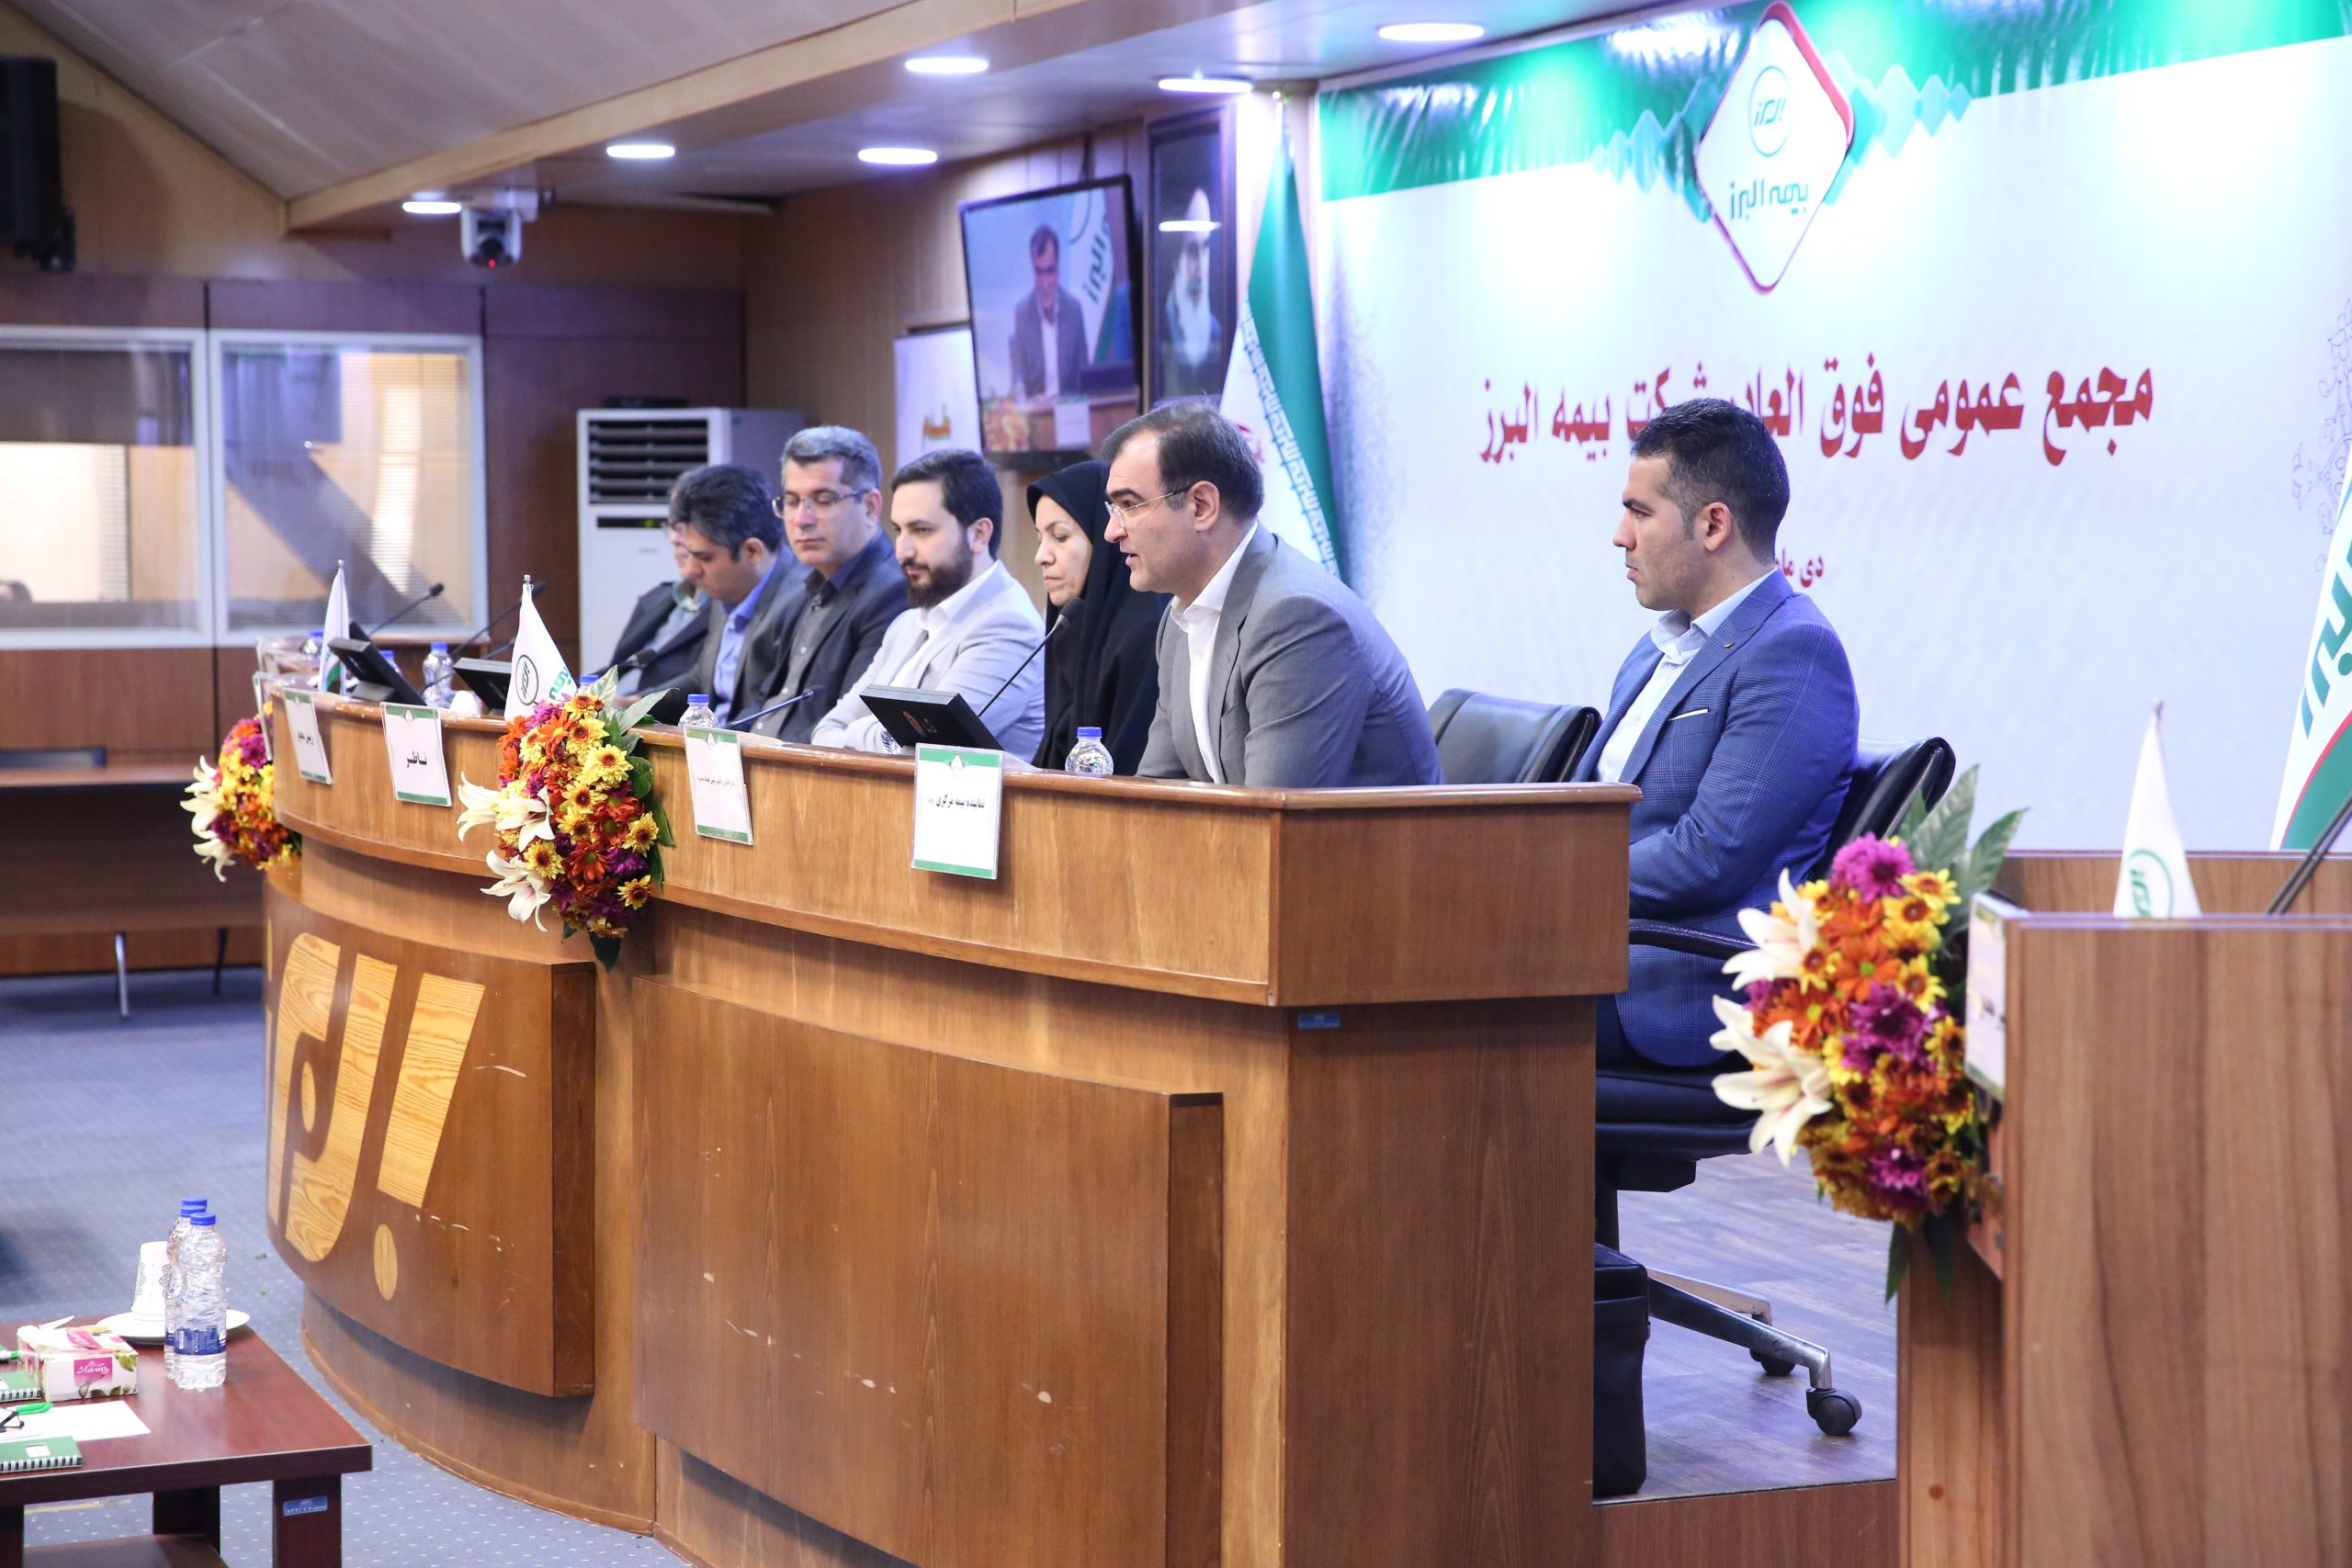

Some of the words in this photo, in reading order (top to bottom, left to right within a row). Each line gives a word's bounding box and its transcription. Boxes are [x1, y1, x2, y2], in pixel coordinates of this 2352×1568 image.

[1479, 378, 1539, 464] البرز
[1552, 387, 1611, 459] بیمه
[1730, 364, 1804, 437] العا
[1820, 351, 1884, 458] فوق
[1900, 371, 2025, 460] عمومی
[2042, 366, 2154, 467] مجمع
[1800, 556, 1824, 588] دی
[406, 750, 427, 768] ناظر
